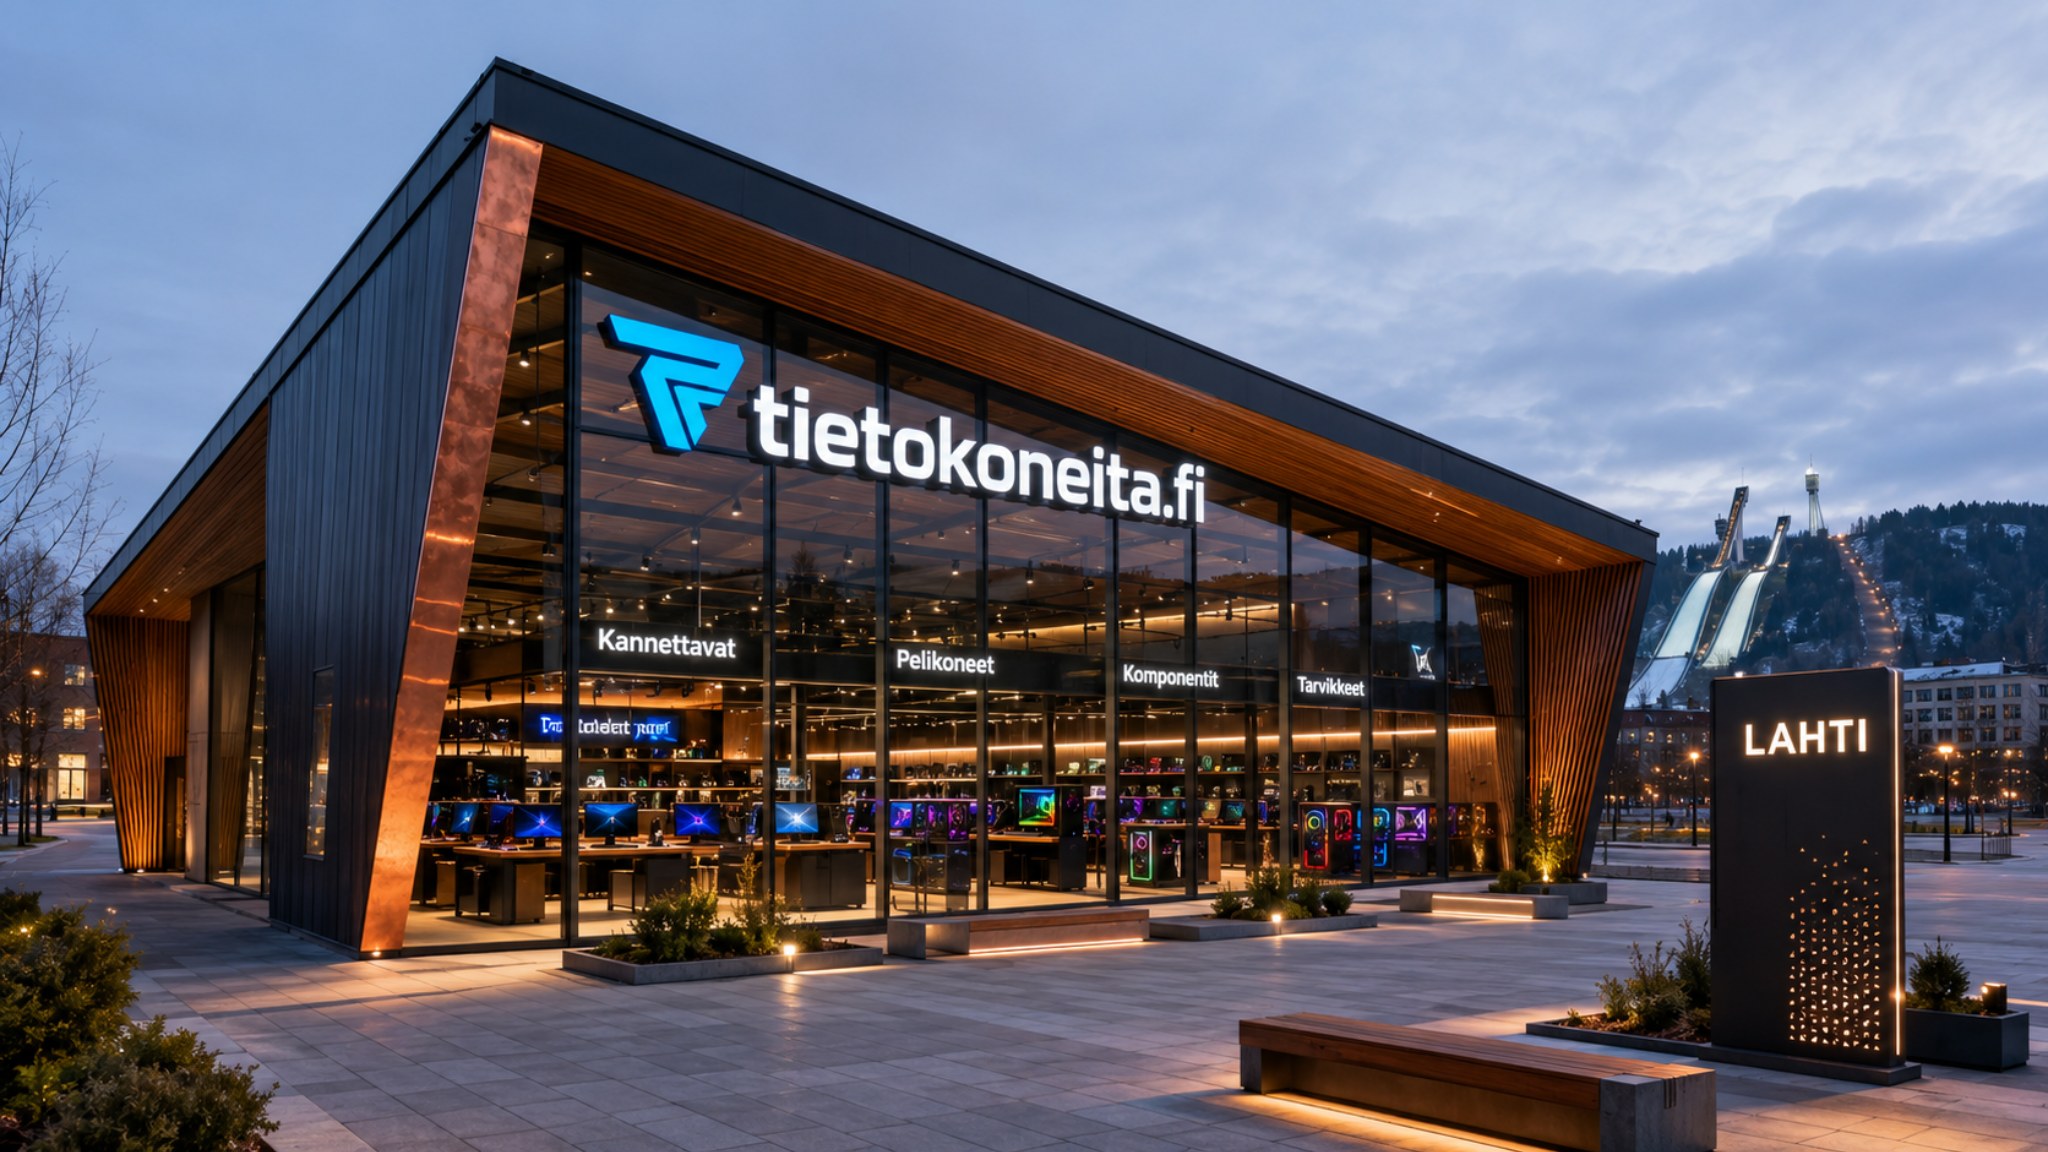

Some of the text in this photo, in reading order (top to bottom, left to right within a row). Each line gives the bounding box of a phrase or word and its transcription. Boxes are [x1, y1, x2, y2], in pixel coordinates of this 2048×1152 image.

[753, 384, 1205, 524] tietokoneita.fi
[598, 627, 737, 659] Kannettavat
[896, 648, 996, 675] Pelikoneet
[1123, 663, 1220, 690] Komponentit
[1297, 675, 1366, 697] Tarvikkeet
[1745, 718, 1868, 756] LAHTI
